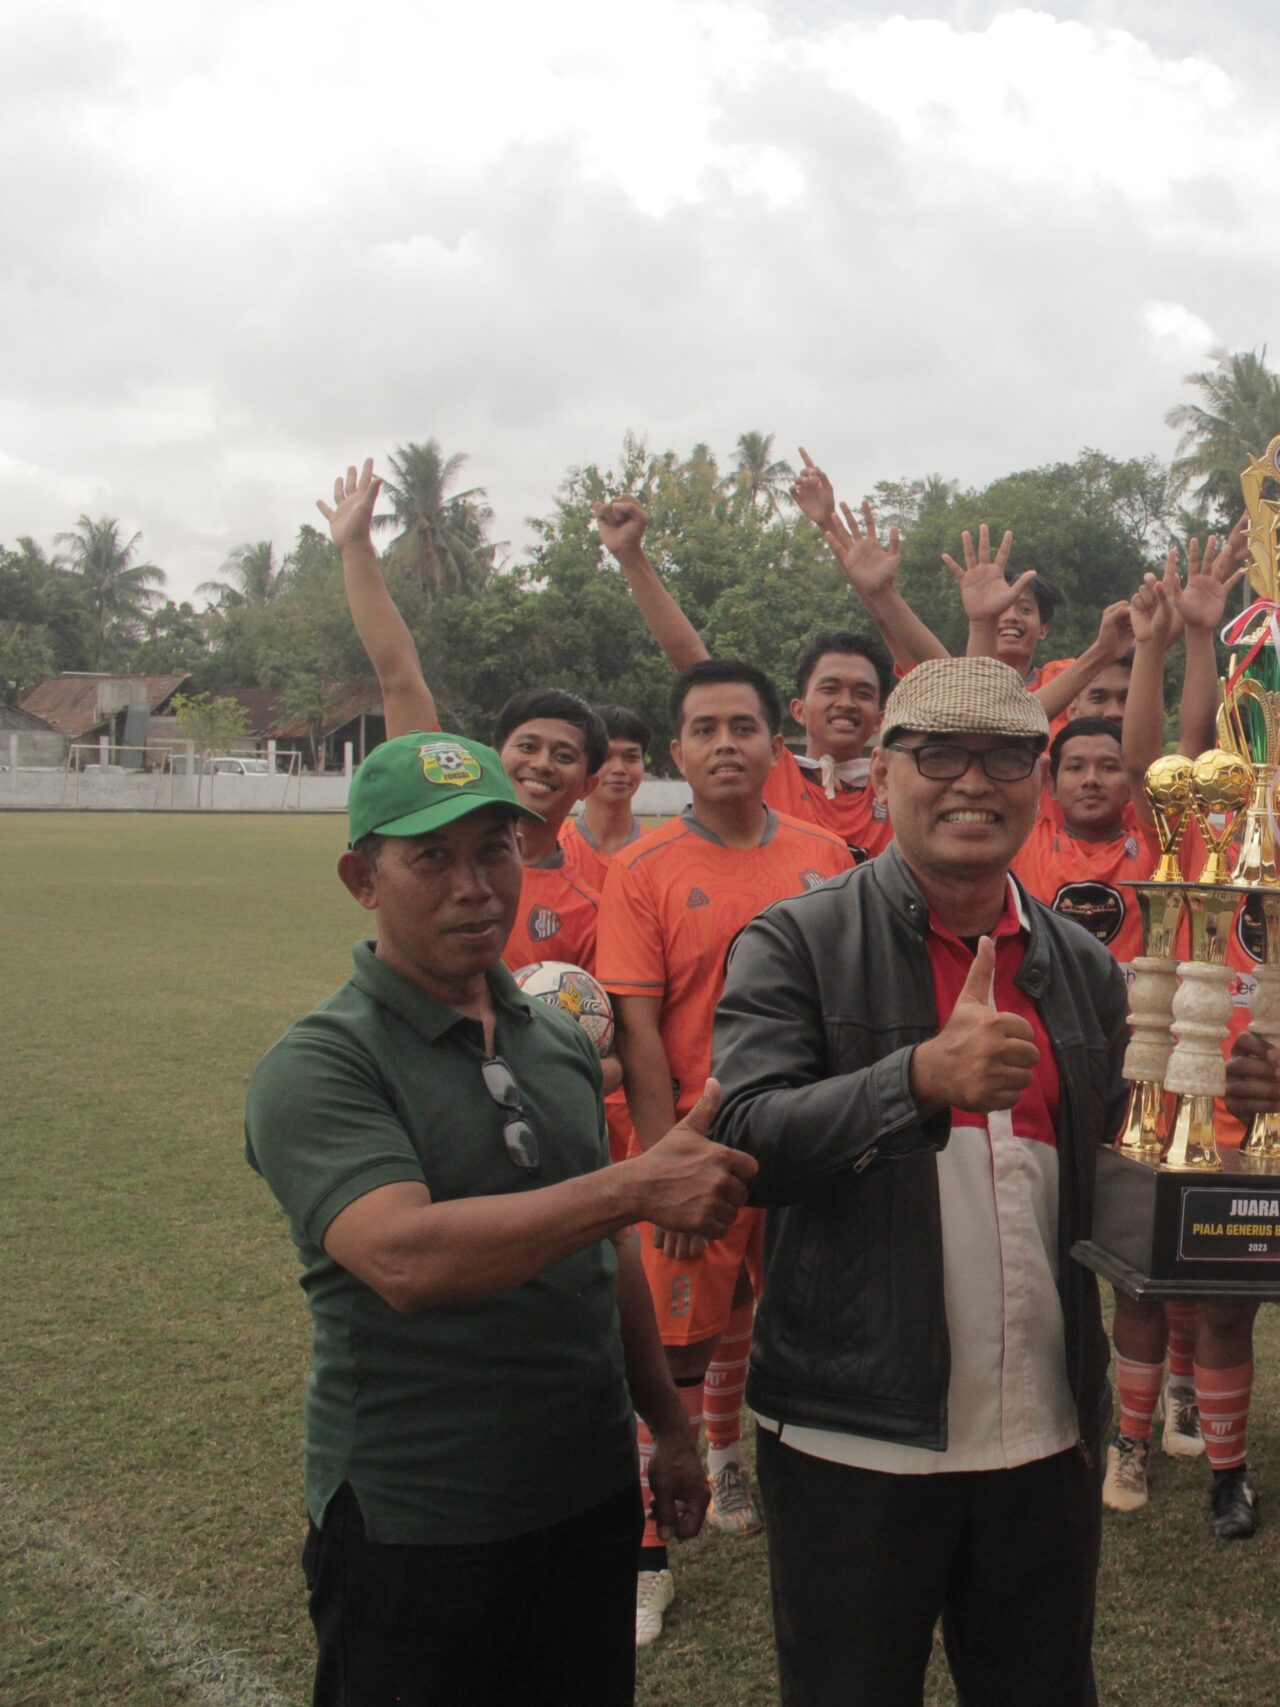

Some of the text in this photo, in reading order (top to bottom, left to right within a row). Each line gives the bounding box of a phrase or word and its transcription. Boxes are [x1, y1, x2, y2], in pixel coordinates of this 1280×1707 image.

[1230, 1200, 1280, 1217] JUARA
[1193, 1223, 1224, 1236] PIALA
[1226, 1224, 1273, 1236] GENERUS
[1248, 1243, 1267, 1252] 2023
